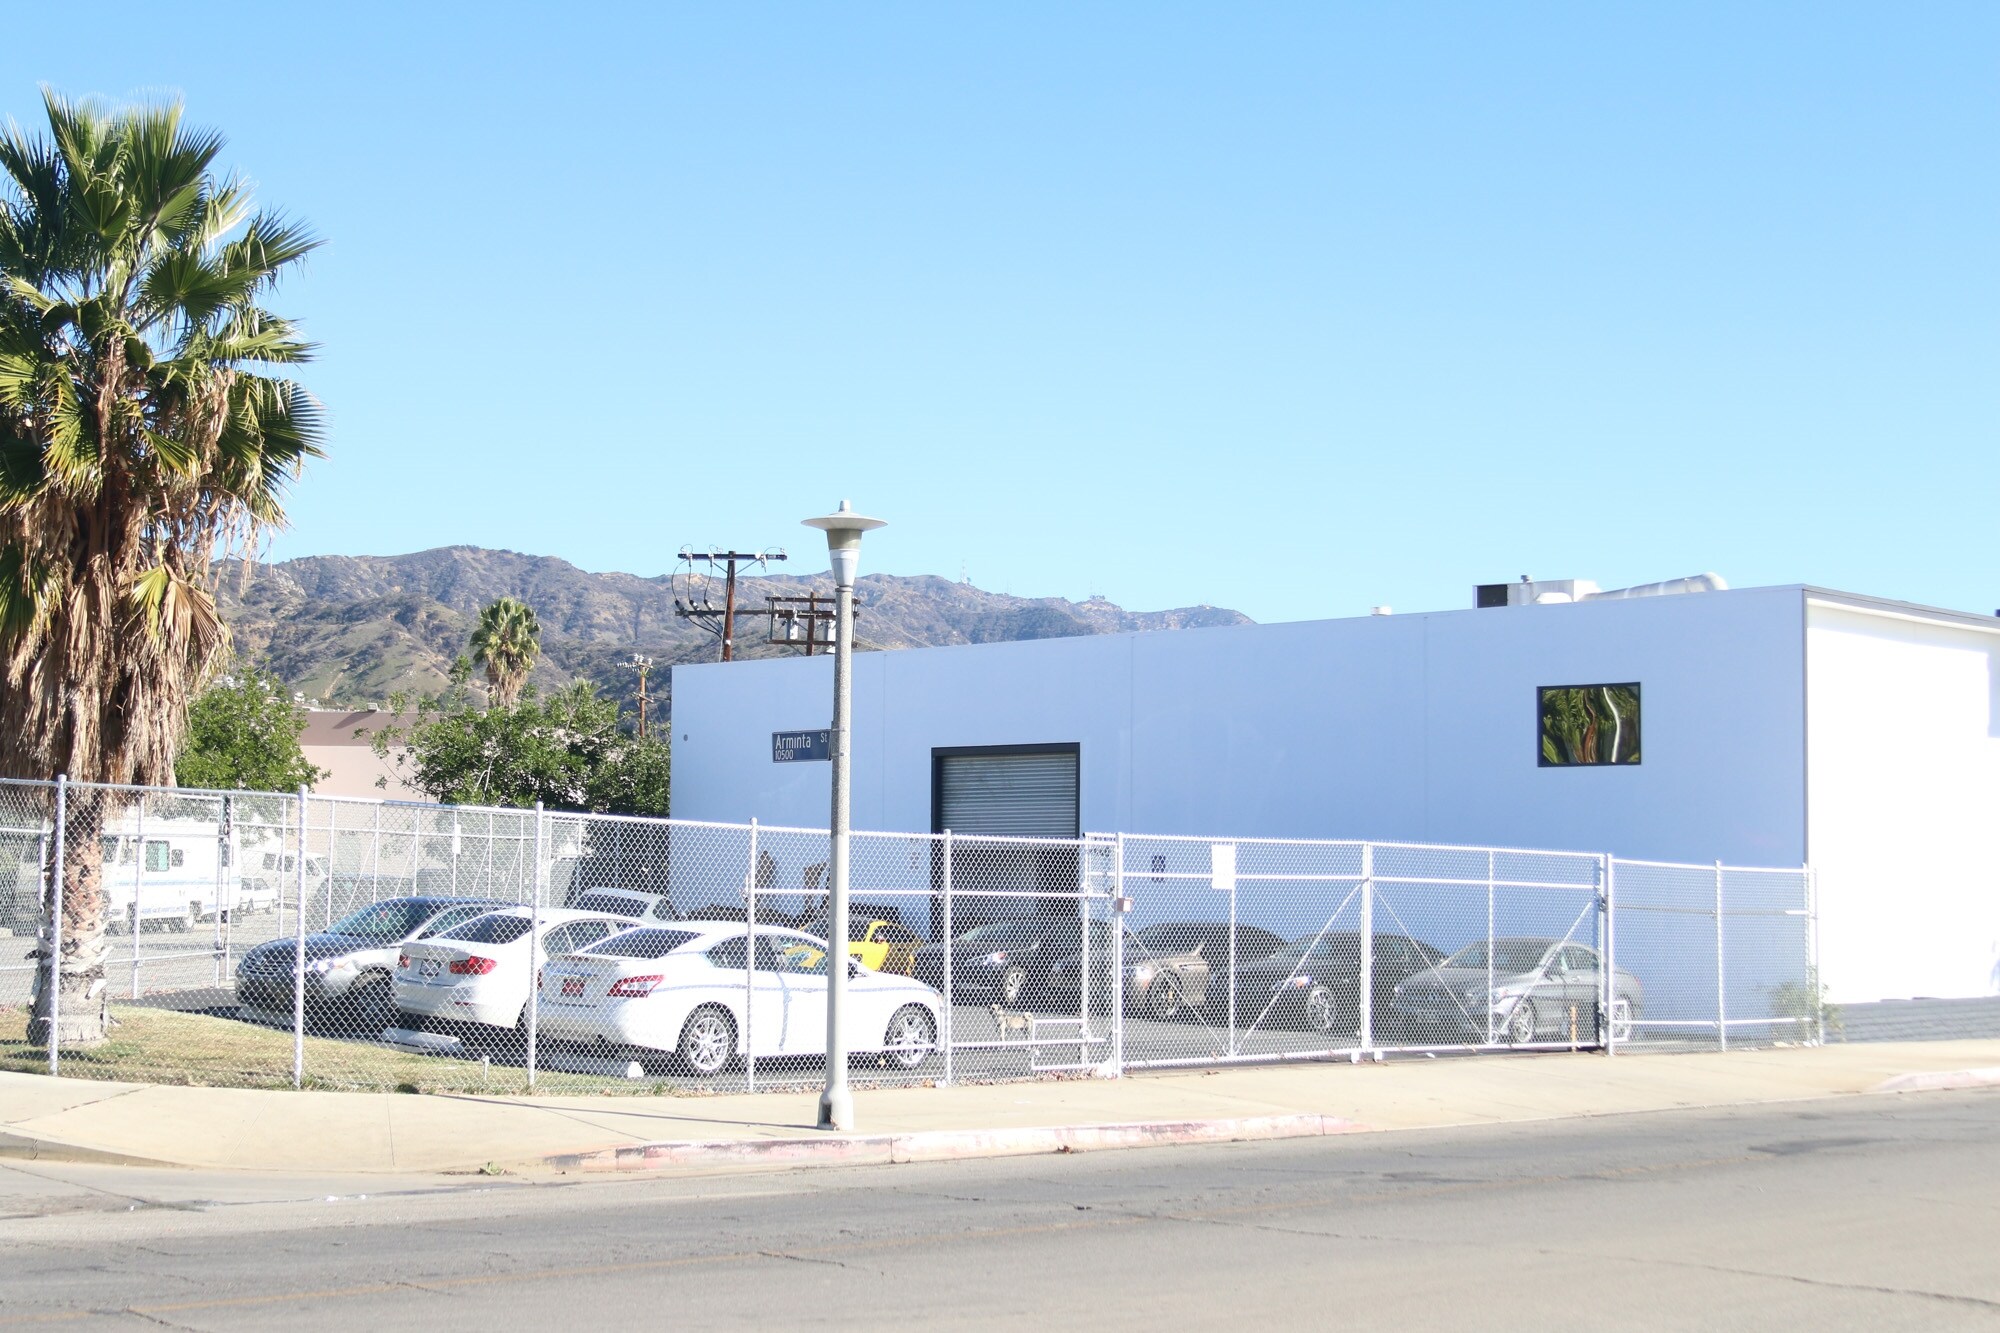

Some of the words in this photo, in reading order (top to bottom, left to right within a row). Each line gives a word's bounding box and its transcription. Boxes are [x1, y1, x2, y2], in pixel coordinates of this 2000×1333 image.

[775, 734, 811, 750] Arminta
[820, 732, 828, 743] St
[775, 749, 794, 761] 10500
